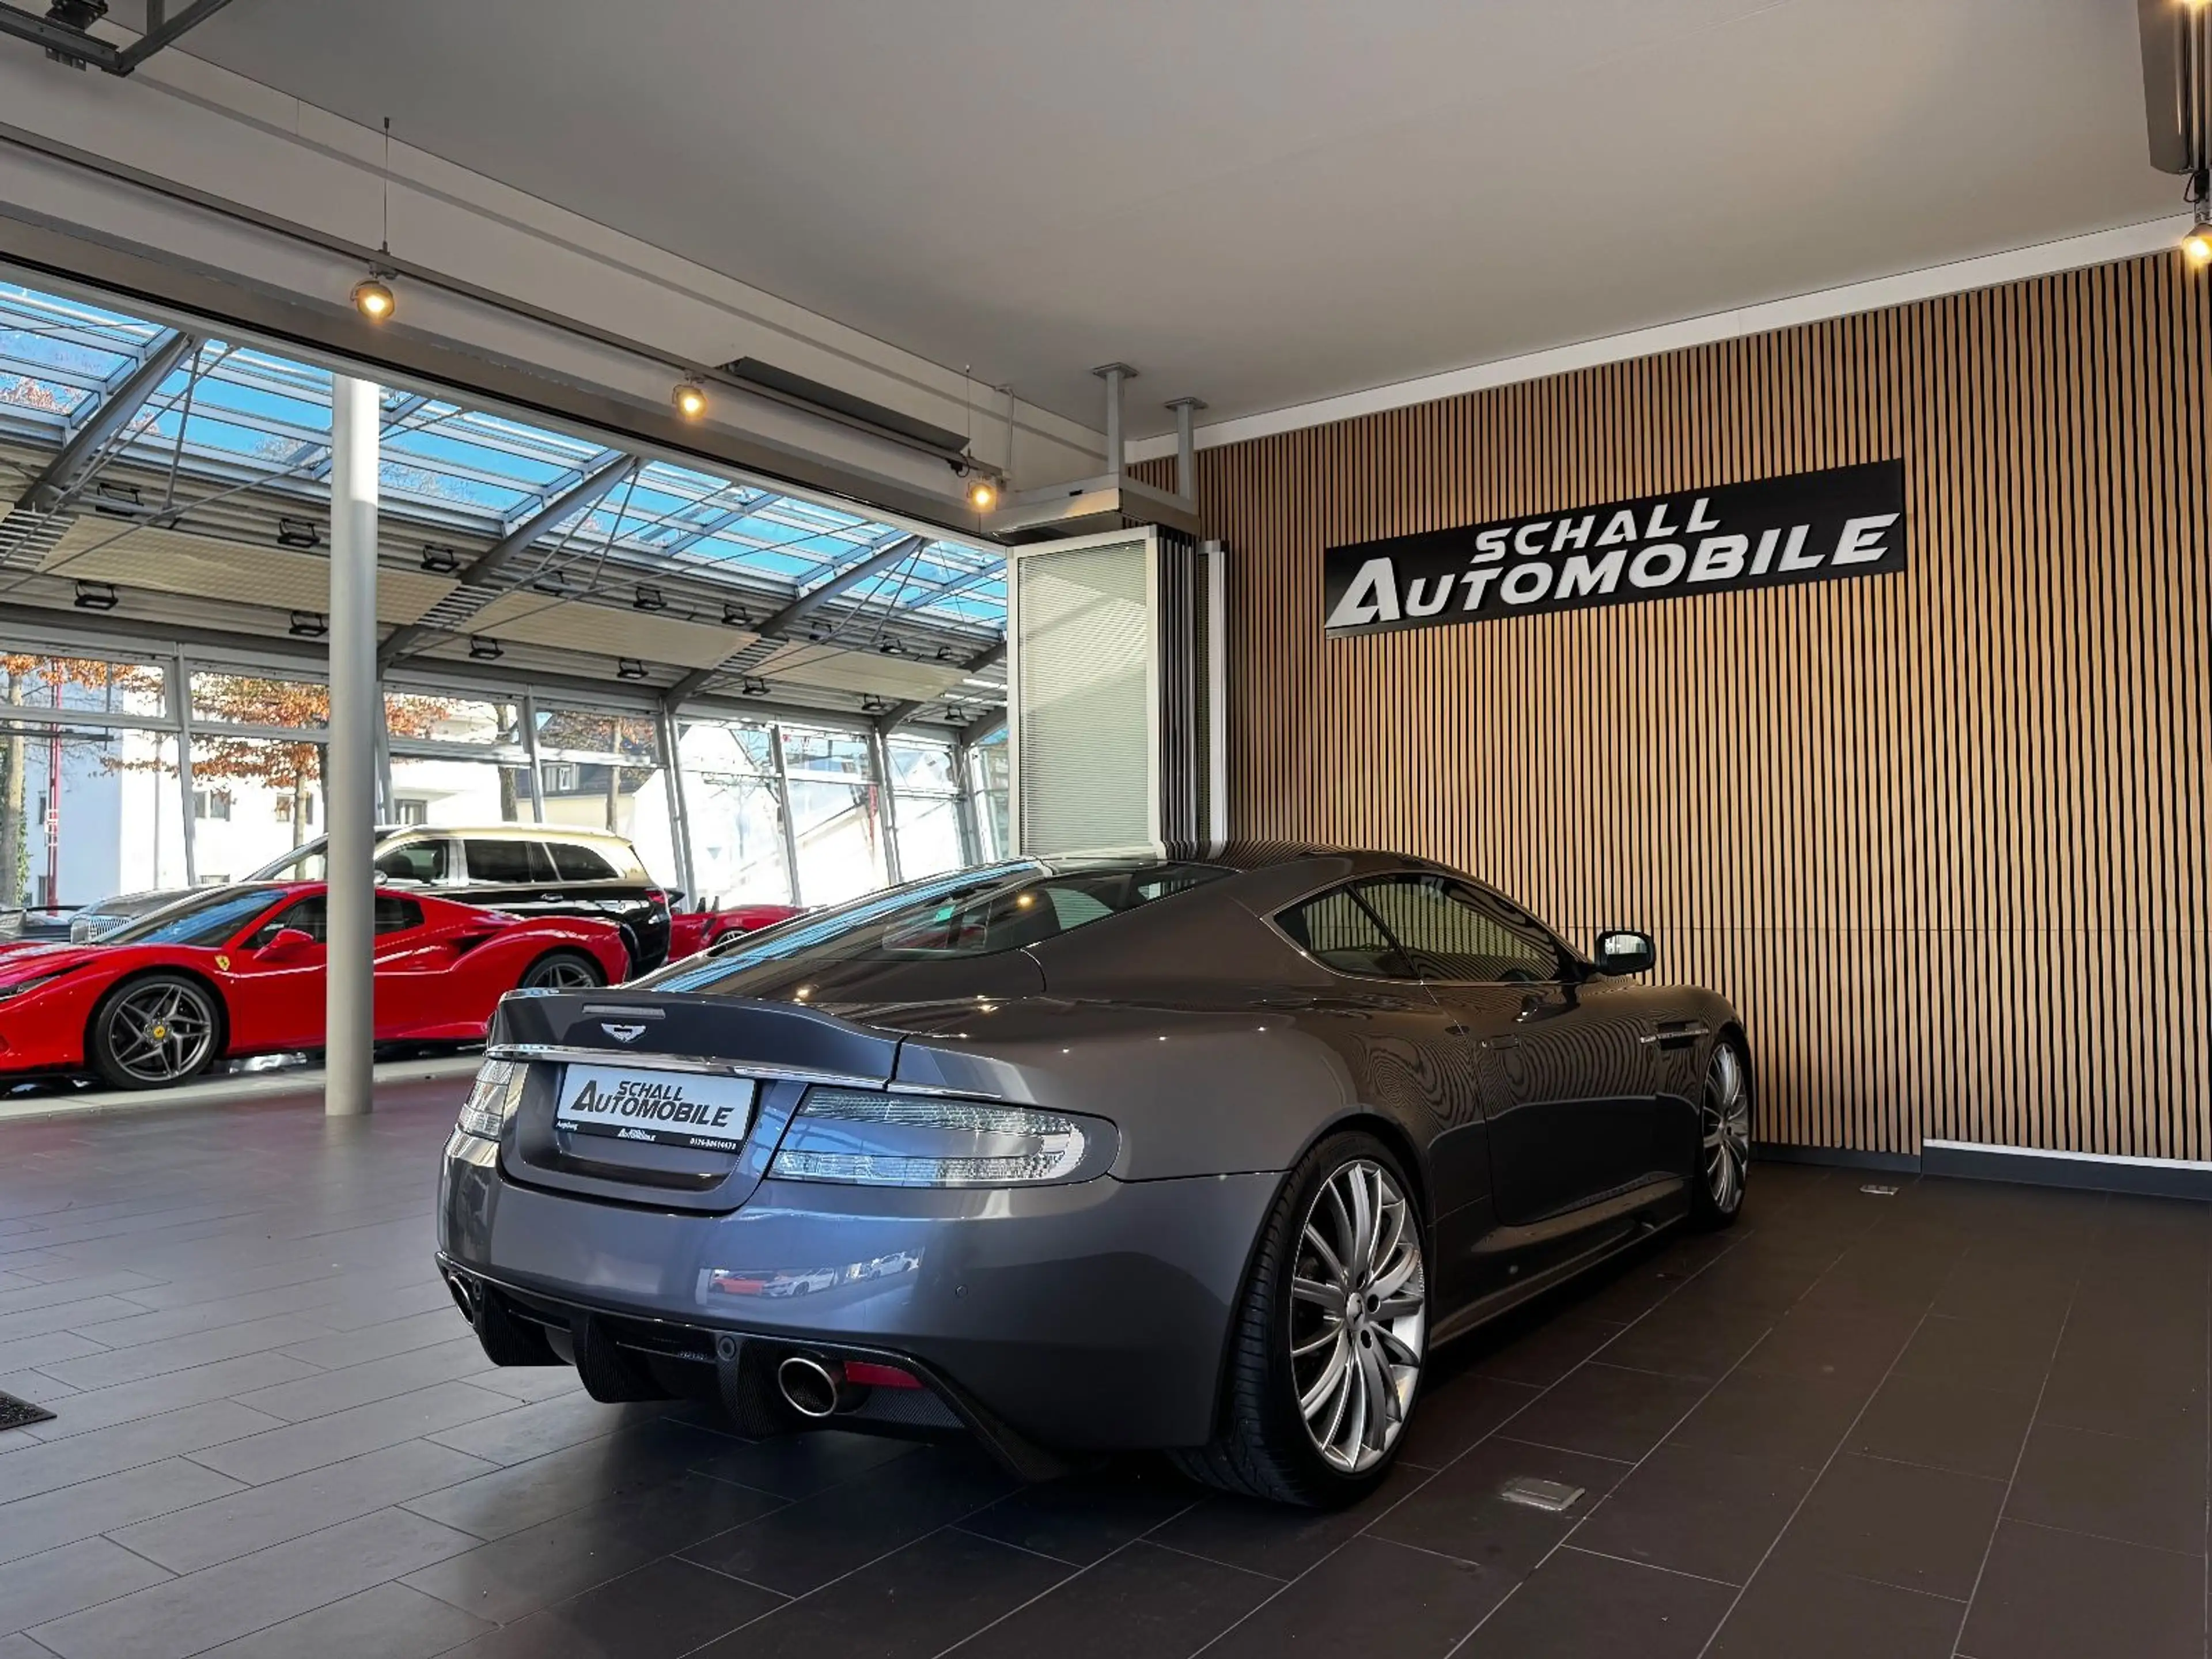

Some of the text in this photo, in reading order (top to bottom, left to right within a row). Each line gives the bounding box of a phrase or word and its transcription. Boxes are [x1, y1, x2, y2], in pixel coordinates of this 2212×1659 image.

[1471, 497, 1721, 564] SCHALL
[1325, 513, 1900, 628] AUTOMOBILE
[570, 1080, 735, 1127] AUTOMOBILE
[617, 1080, 684, 1101] SCHALL
